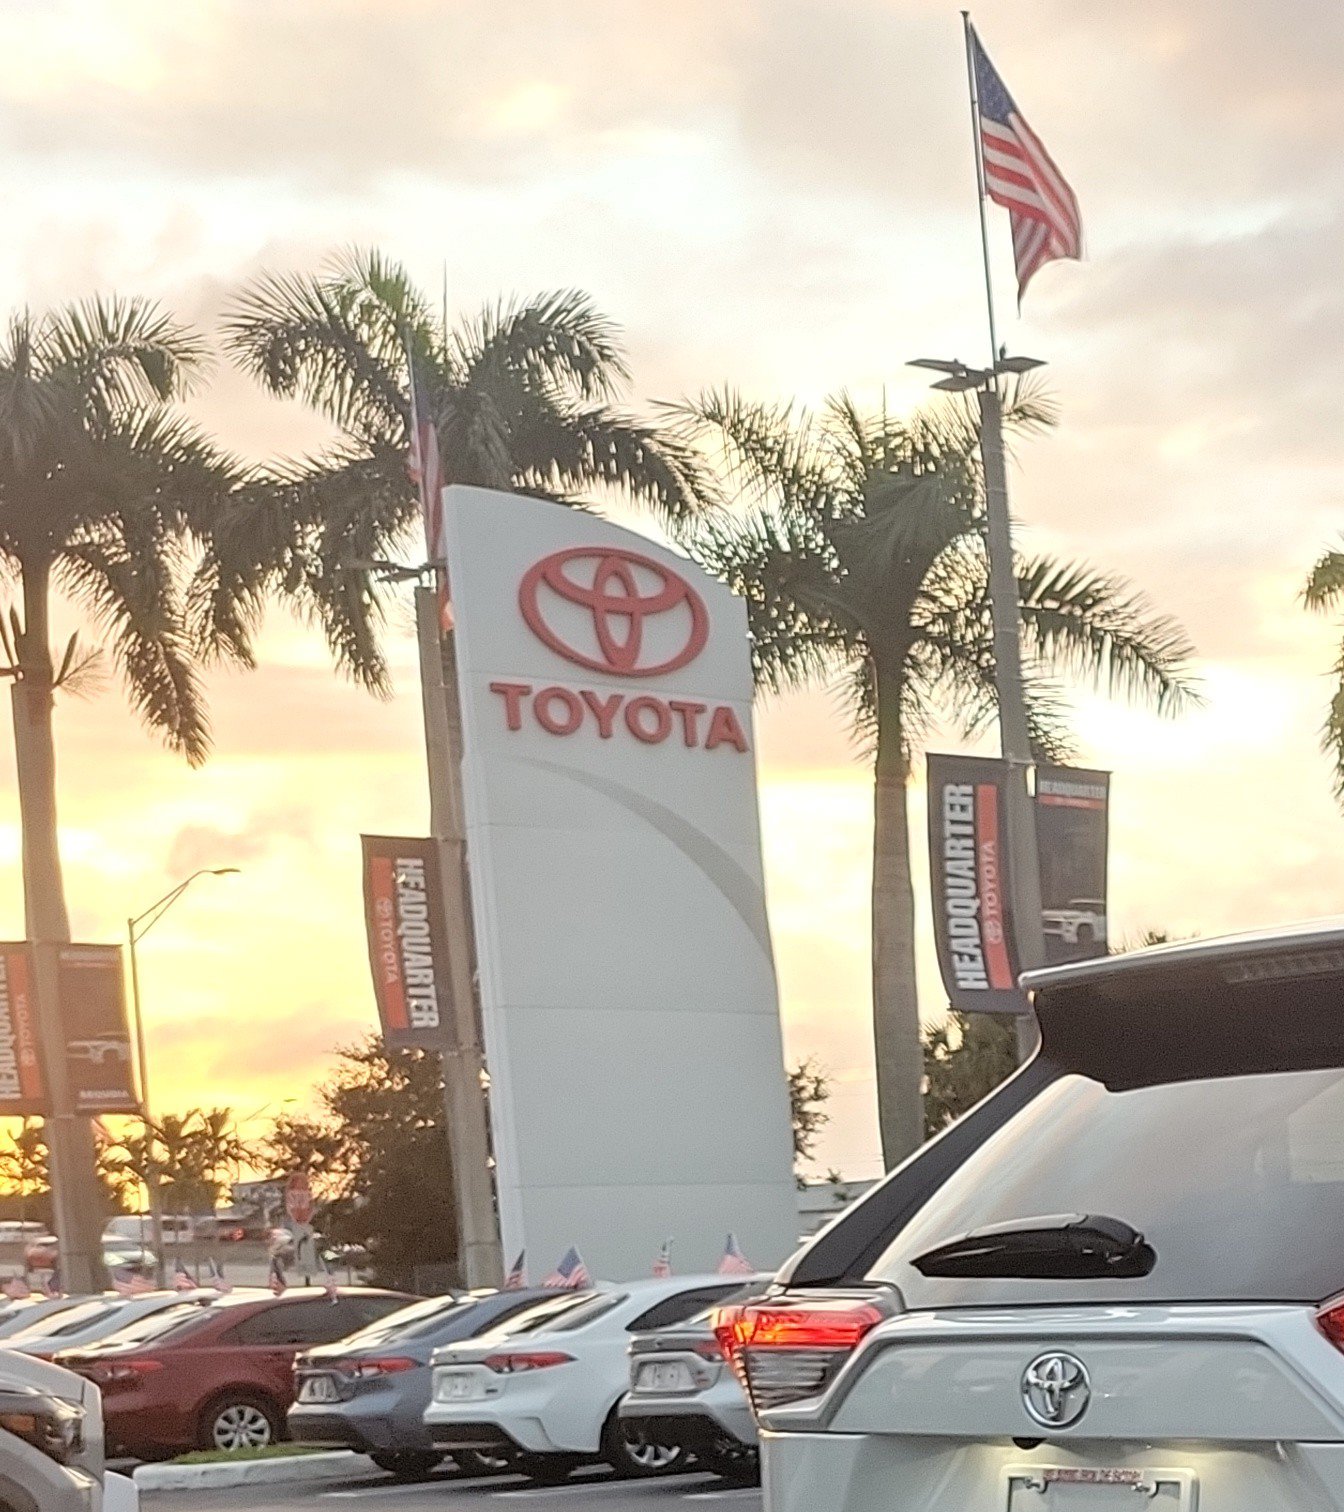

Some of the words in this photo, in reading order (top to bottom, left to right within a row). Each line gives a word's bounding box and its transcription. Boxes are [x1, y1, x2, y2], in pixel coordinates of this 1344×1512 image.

[489, 682, 750, 753] TOYOTA
[943, 784, 990, 990] HEADQUARTER
[981, 841, 1003, 919] TOYOTA
[381, 918, 398, 984] TOYOTA
[396, 857, 440, 1029] HEADQUARTER
